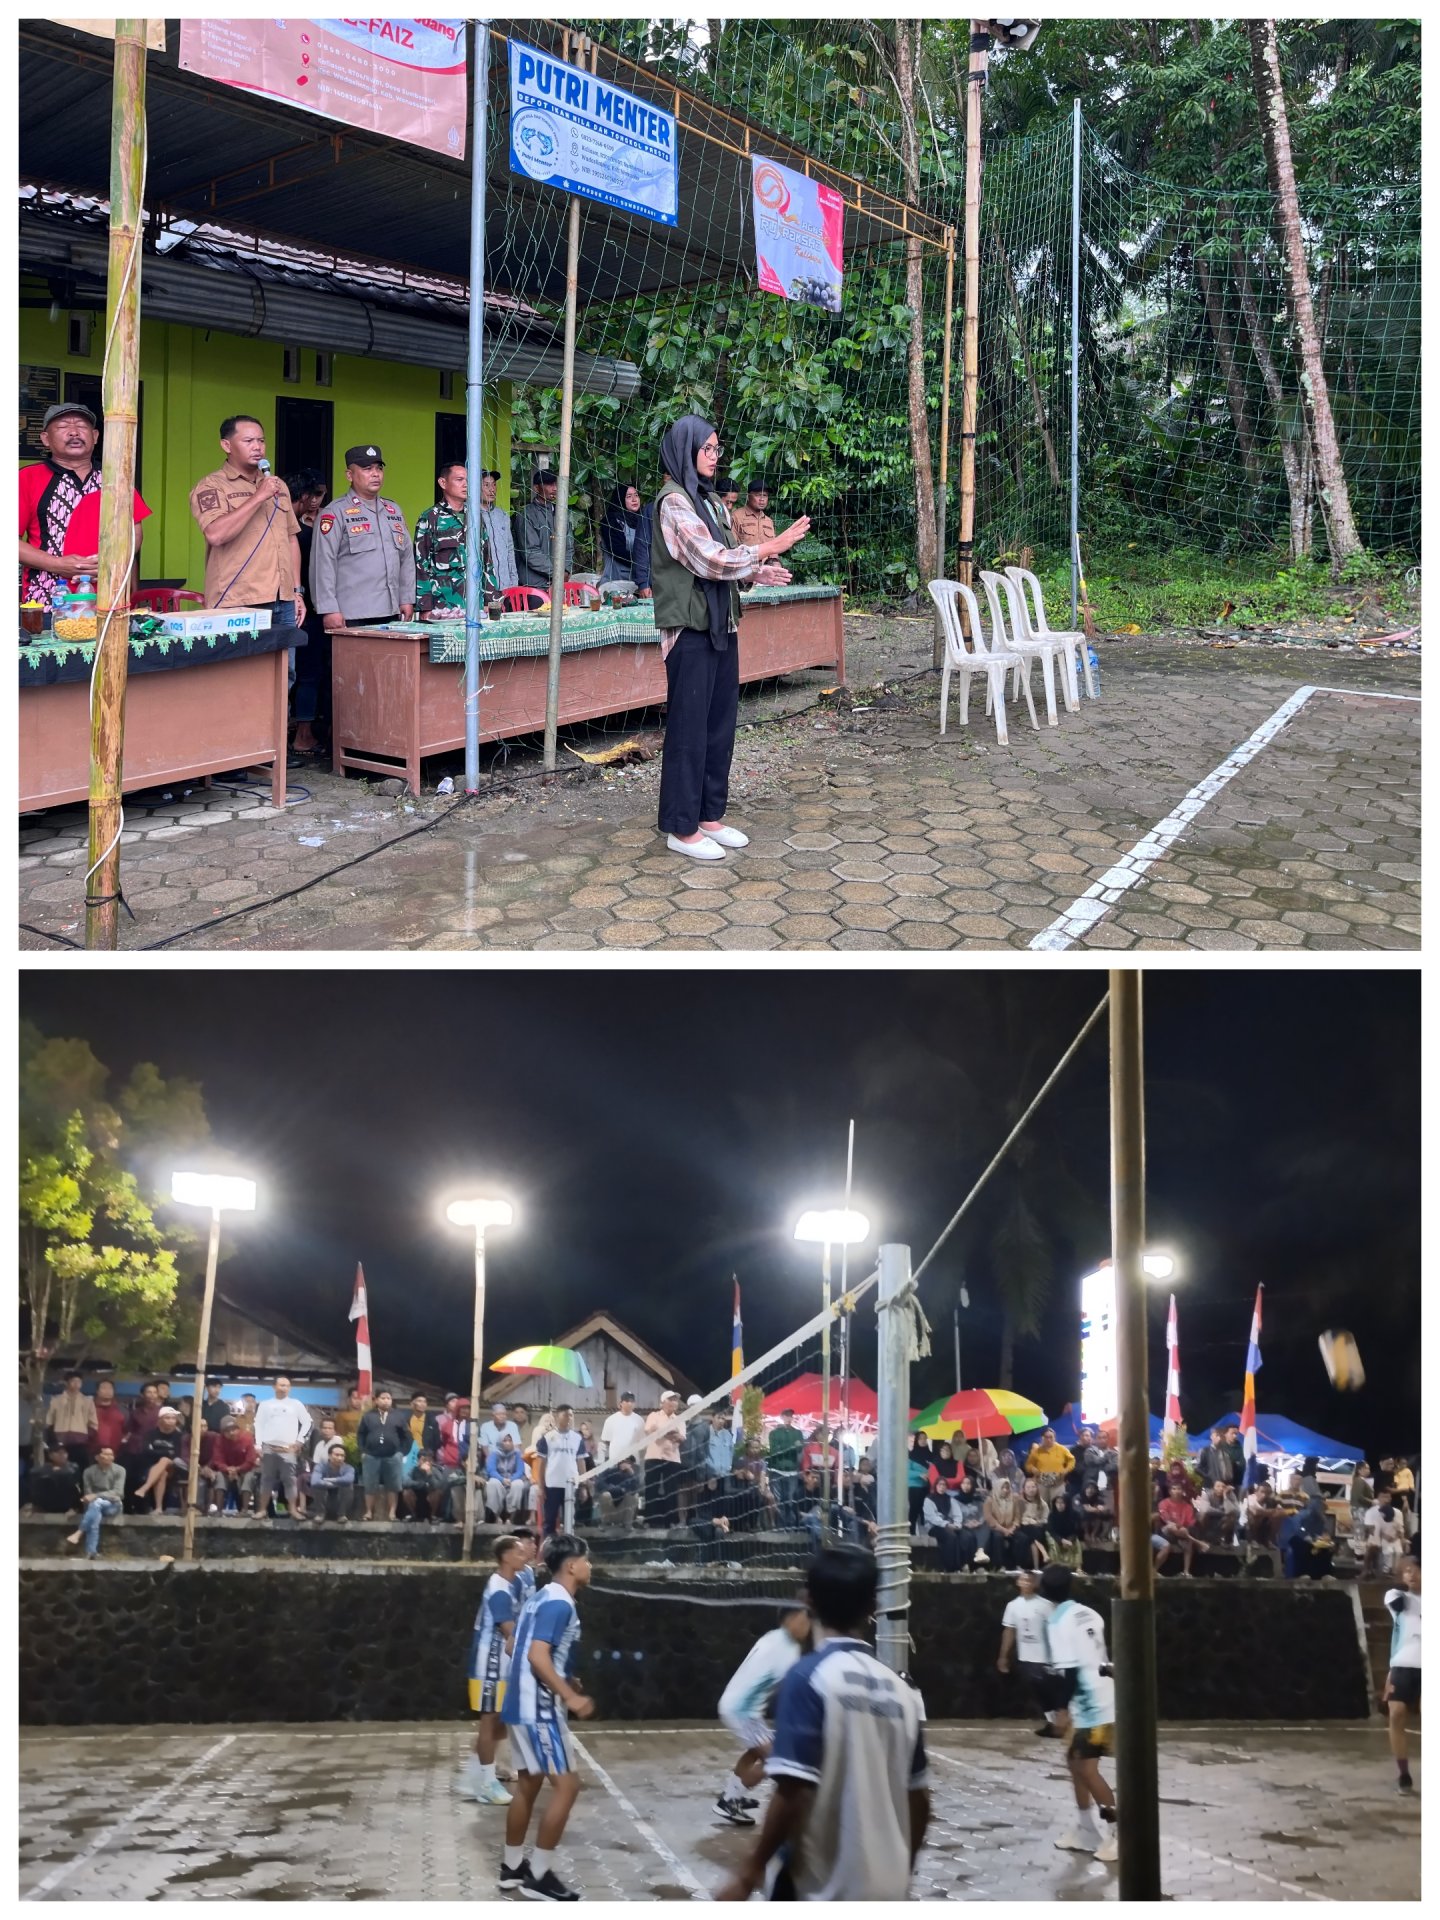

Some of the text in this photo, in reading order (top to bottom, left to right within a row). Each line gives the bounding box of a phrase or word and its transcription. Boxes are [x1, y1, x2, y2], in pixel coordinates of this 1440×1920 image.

[338, 18, 415, 49] -FAIZ
[411, 18, 456, 41] dang
[519, 52, 589, 111] PUTRI
[595, 86, 670, 148] MENTER
[518, 93, 670, 161] DEPOT IKAN NILA DAN TONGKOL PRESTO
[577, 185, 603, 198] PRODUK
[605, 194, 618, 204] ASLI
